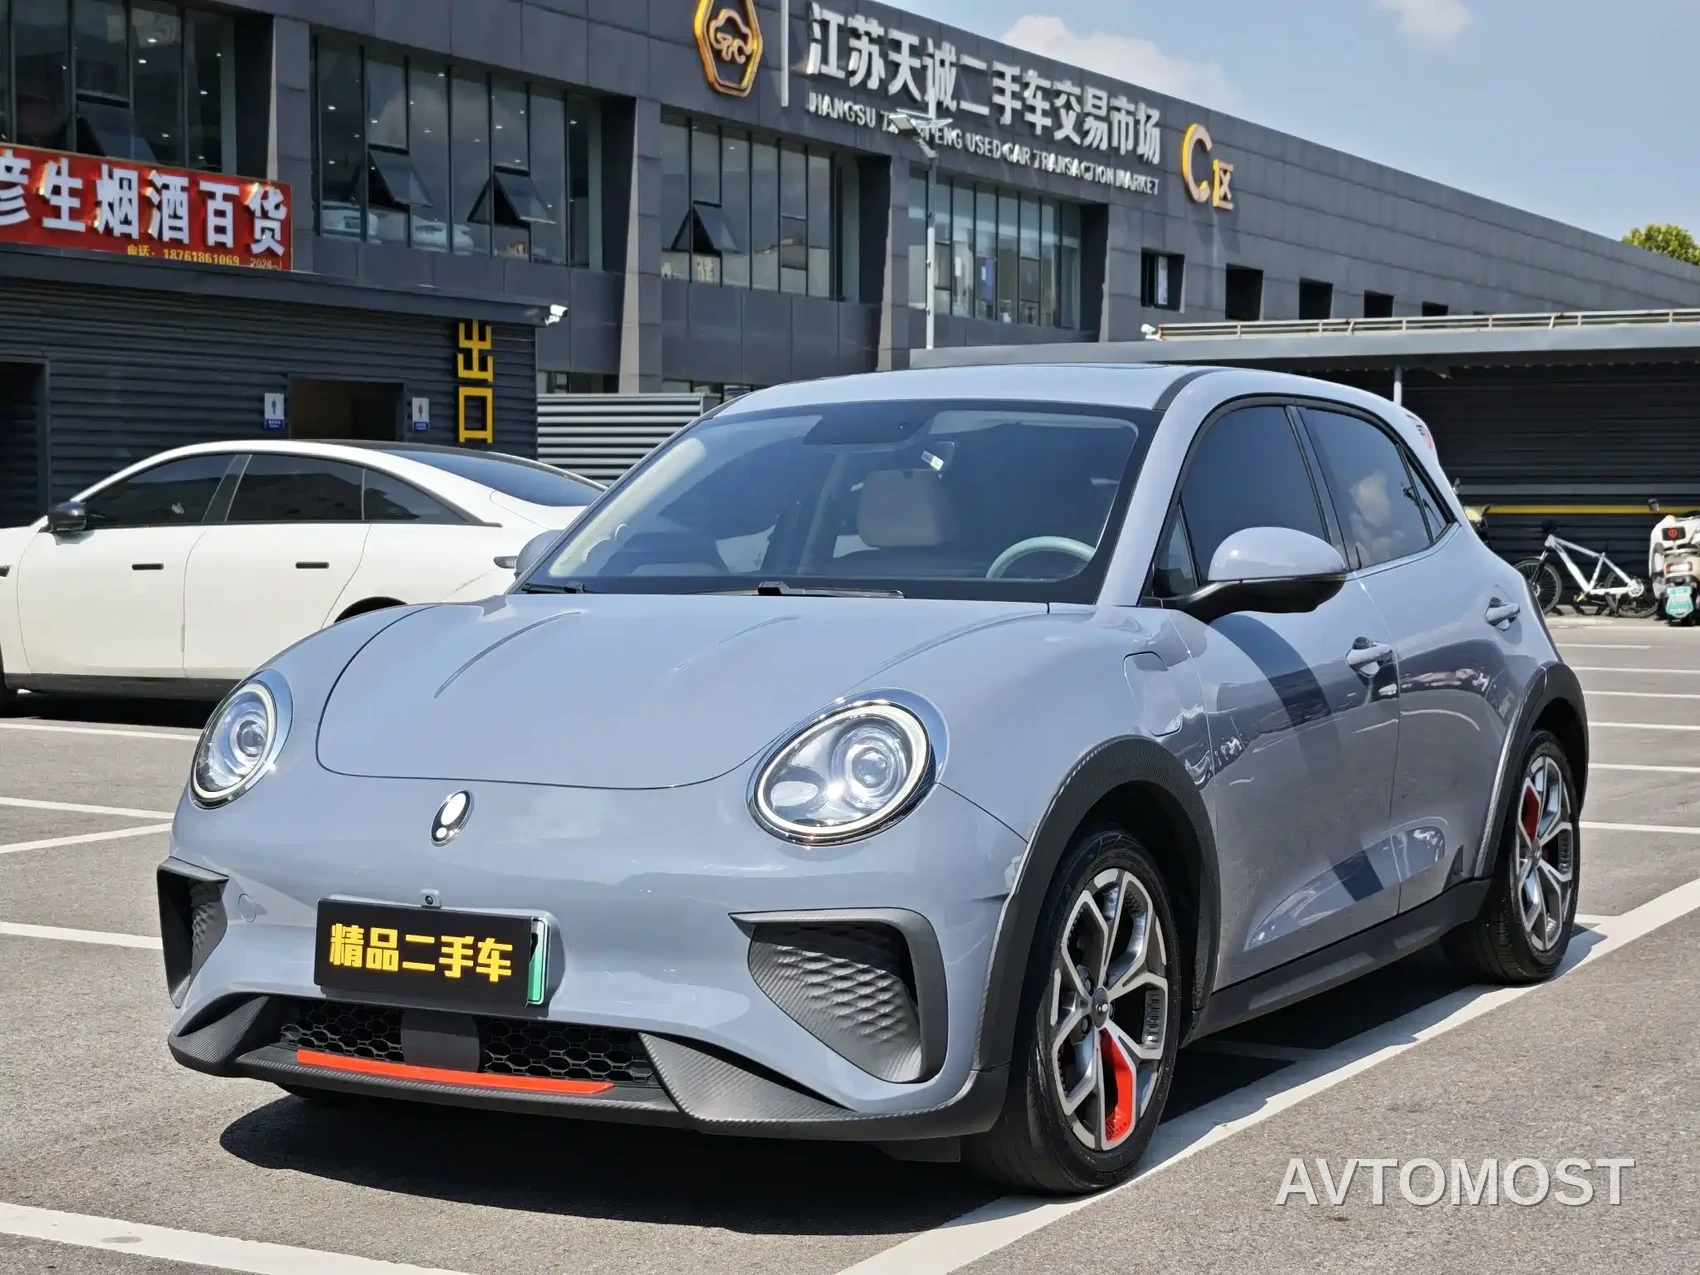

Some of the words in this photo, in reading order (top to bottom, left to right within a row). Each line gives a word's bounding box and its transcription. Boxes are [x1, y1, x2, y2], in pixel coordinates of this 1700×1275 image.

[806, 1, 1161, 164] 江苏天诚二手车交易市场
[807, 91, 876, 128] JIANGSU
[966, 132, 1001, 159] USED
[1002, 143, 1031, 166] CAR
[1033, 150, 1114, 185] TRANSACTION
[1115, 169, 1160, 195] MARKET
[0, 149, 288, 257] 彦生烟酒百货
[457, 319, 494, 444] 出口
[329, 923, 513, 982] 精品二手车
